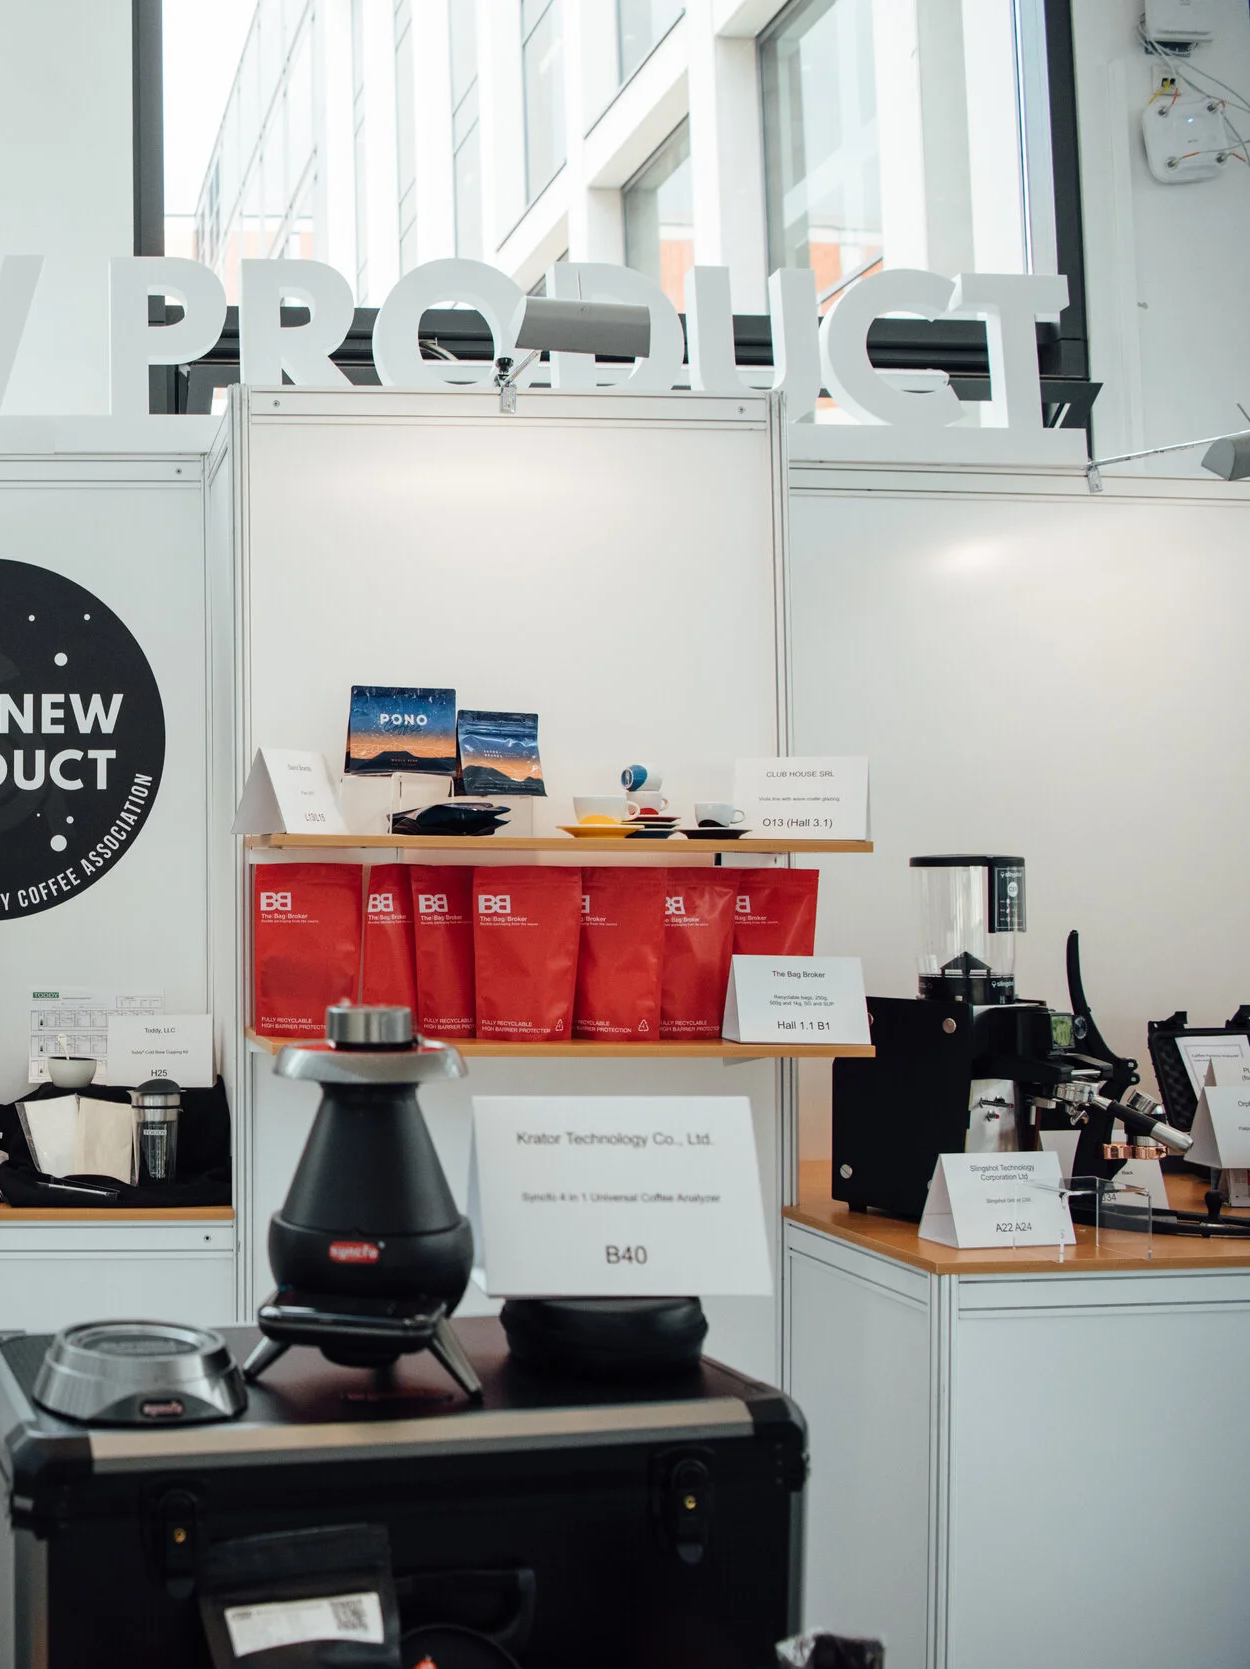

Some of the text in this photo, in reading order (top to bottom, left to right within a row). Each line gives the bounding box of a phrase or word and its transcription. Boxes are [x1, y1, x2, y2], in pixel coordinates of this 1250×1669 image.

[110, 256, 1070, 429] PRODUCT
[379, 713, 428, 726] PONO
[819, 770, 835, 778] SRL
[786, 818, 810, 828] (Hall
[813, 818, 833, 829] 3.1)
[17, 867, 81, 909] COFFEE
[81, 773, 153, 876] ASSOCIATION
[786, 970, 801, 979] Bag
[144, 1027, 163, 1035] Toddy,
[777, 1020, 831, 1031] Hall 1.1 B1
[150, 1069, 168, 1077] H25
[516, 1131, 715, 1149] Krator Technology Co., Ltd.
[969, 1164, 1035, 1173] Slingshot Technology
[980, 1174, 1018, 1182] Corporation
[569, 1192, 579, 1202] in
[590, 1192, 638, 1202] Universal
[641, 1192, 674, 1202] Coffee
[676, 1192, 721, 1204] Analyzer
[995, 1222, 1032, 1233] A22 A24
[605, 1245, 648, 1265] B40
